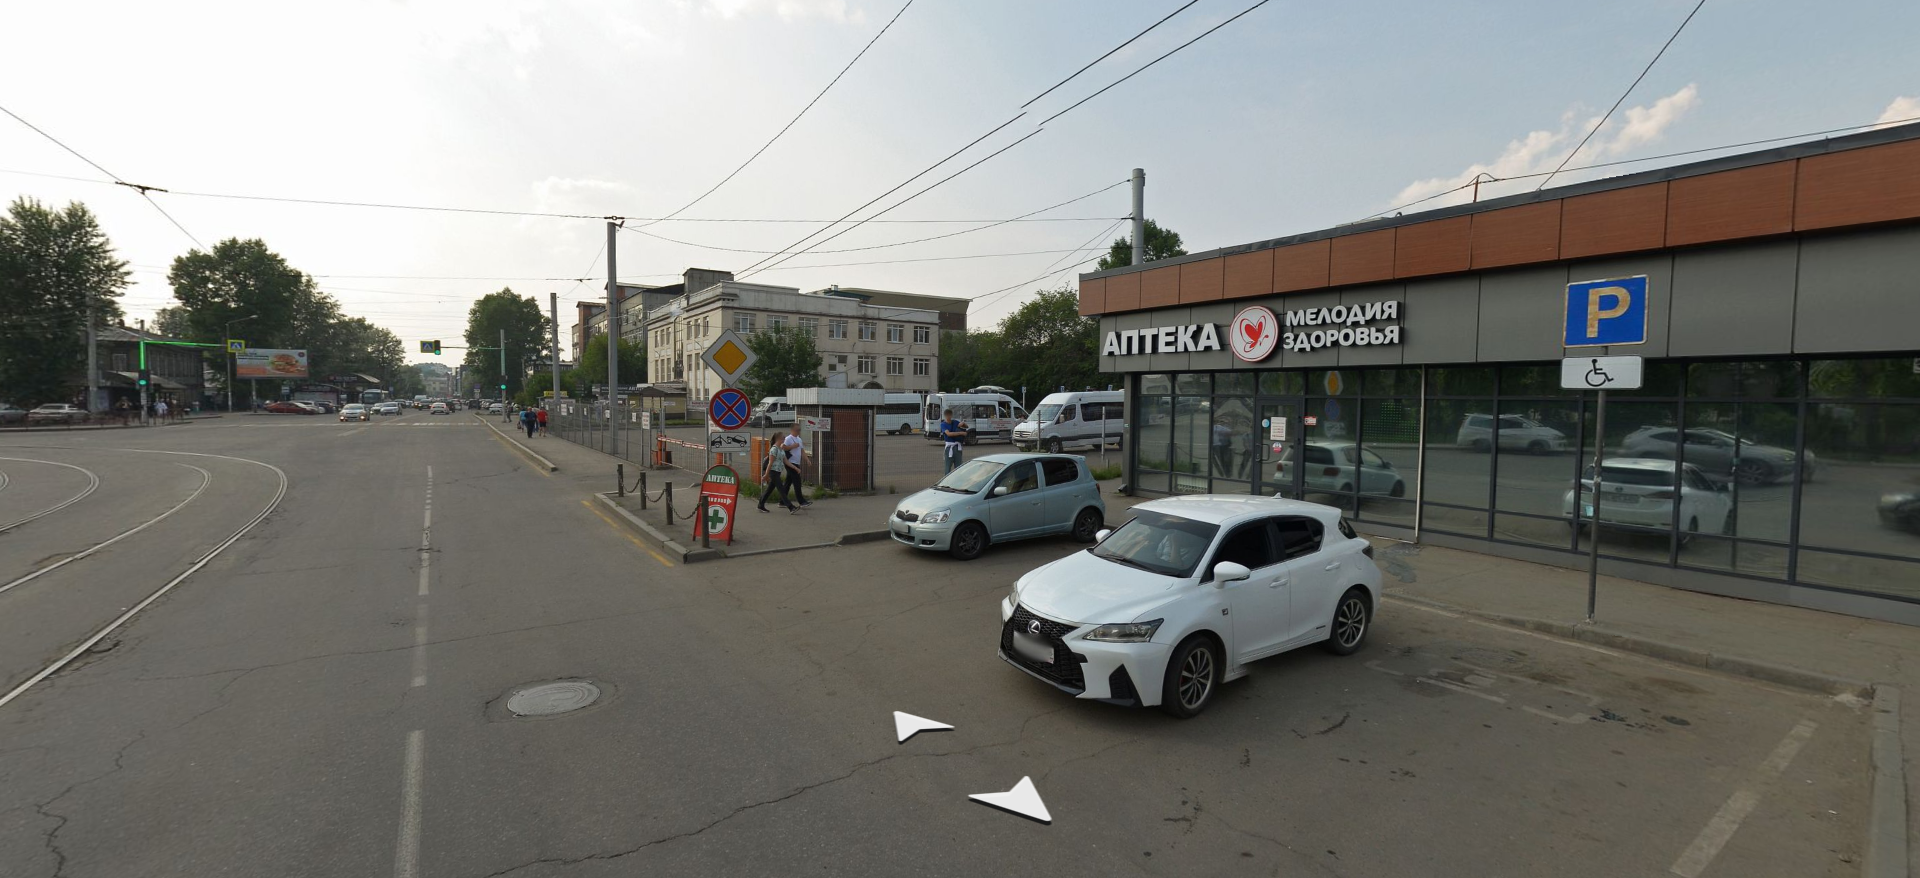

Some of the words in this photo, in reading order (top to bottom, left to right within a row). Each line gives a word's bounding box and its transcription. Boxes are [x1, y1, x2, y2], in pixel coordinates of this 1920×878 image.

[1285, 300, 1398, 326] МЕЛОДИЯ
[1586, 286, 1631, 338] P
[1102, 322, 1221, 356] АПТЕКА
[1283, 325, 1400, 352] ЗДОРОВЬЯ
[705, 474, 736, 485] АПТЕКА
